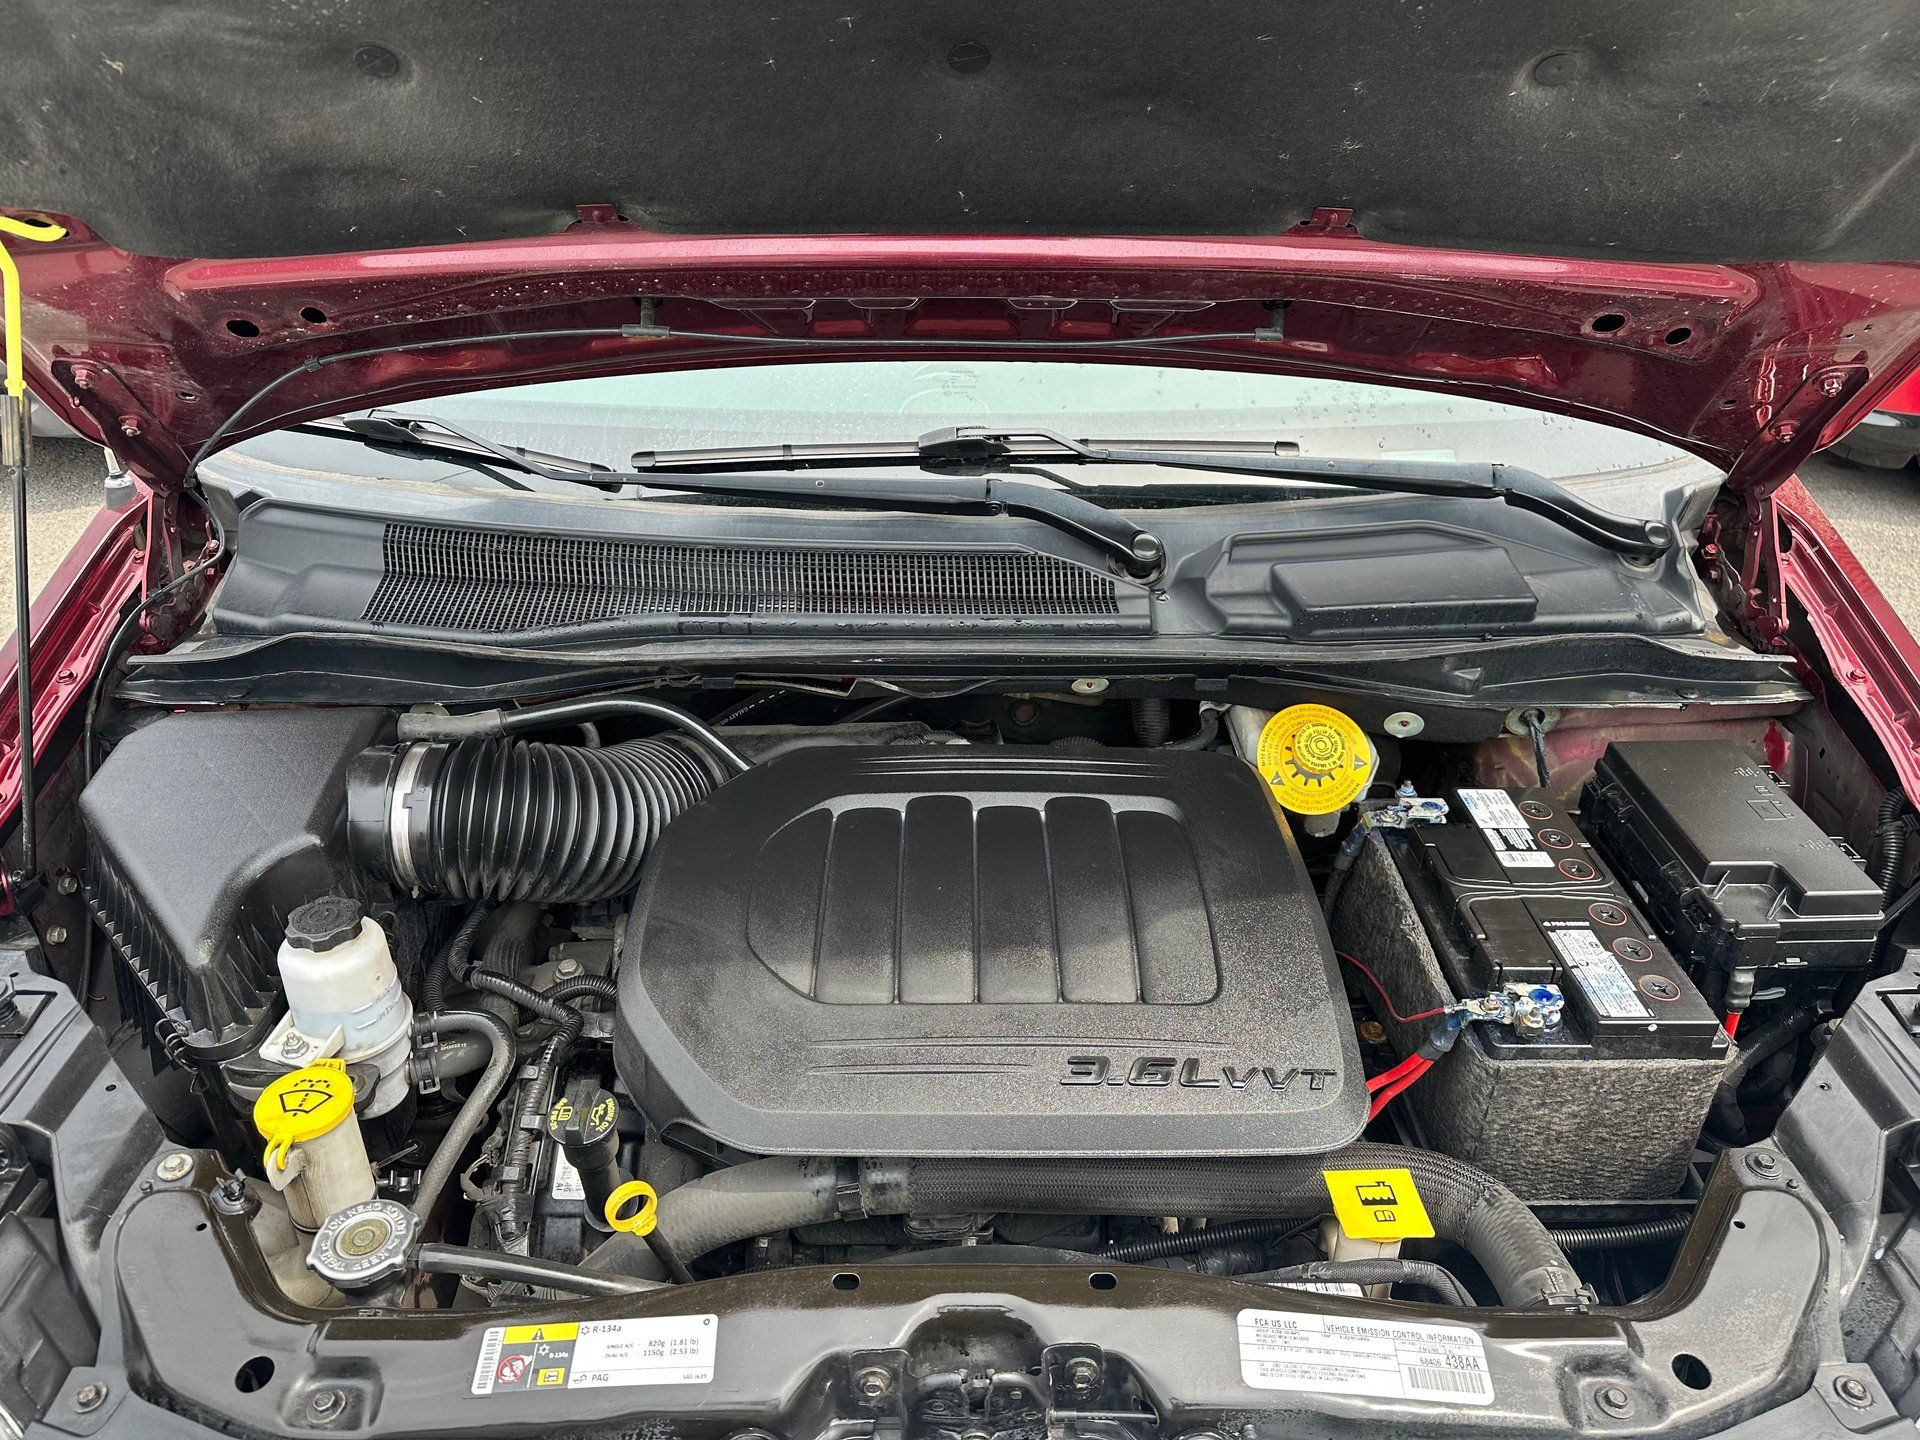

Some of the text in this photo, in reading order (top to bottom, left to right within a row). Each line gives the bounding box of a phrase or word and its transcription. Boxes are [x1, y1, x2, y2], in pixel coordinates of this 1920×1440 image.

[595, 1098, 615, 1132] ENGINE OIL
[347, 1202, 382, 1217] OPEN
[353, 1250, 390, 1270] KEEP
[593, 1324, 621, 1333] R-134a
[1255, 1318, 1298, 1329] FCA US LLC
[1326, 1324, 1354, 1334] VEHICLE
[1357, 1327, 1390, 1337] EMISSION
[1392, 1330, 1424, 1340] CONTROL
[1426, 1334, 1474, 1344] INFORMATION
[689, 1338, 699, 1346] lb)
[643, 1349, 664, 1357] 1150g
[669, 1348, 687, 1356] (2.53
[689, 1347, 699, 1355] lb)
[1420, 1355, 1480, 1370] 68406 438AA
[591, 1374, 609, 1382] PAG
